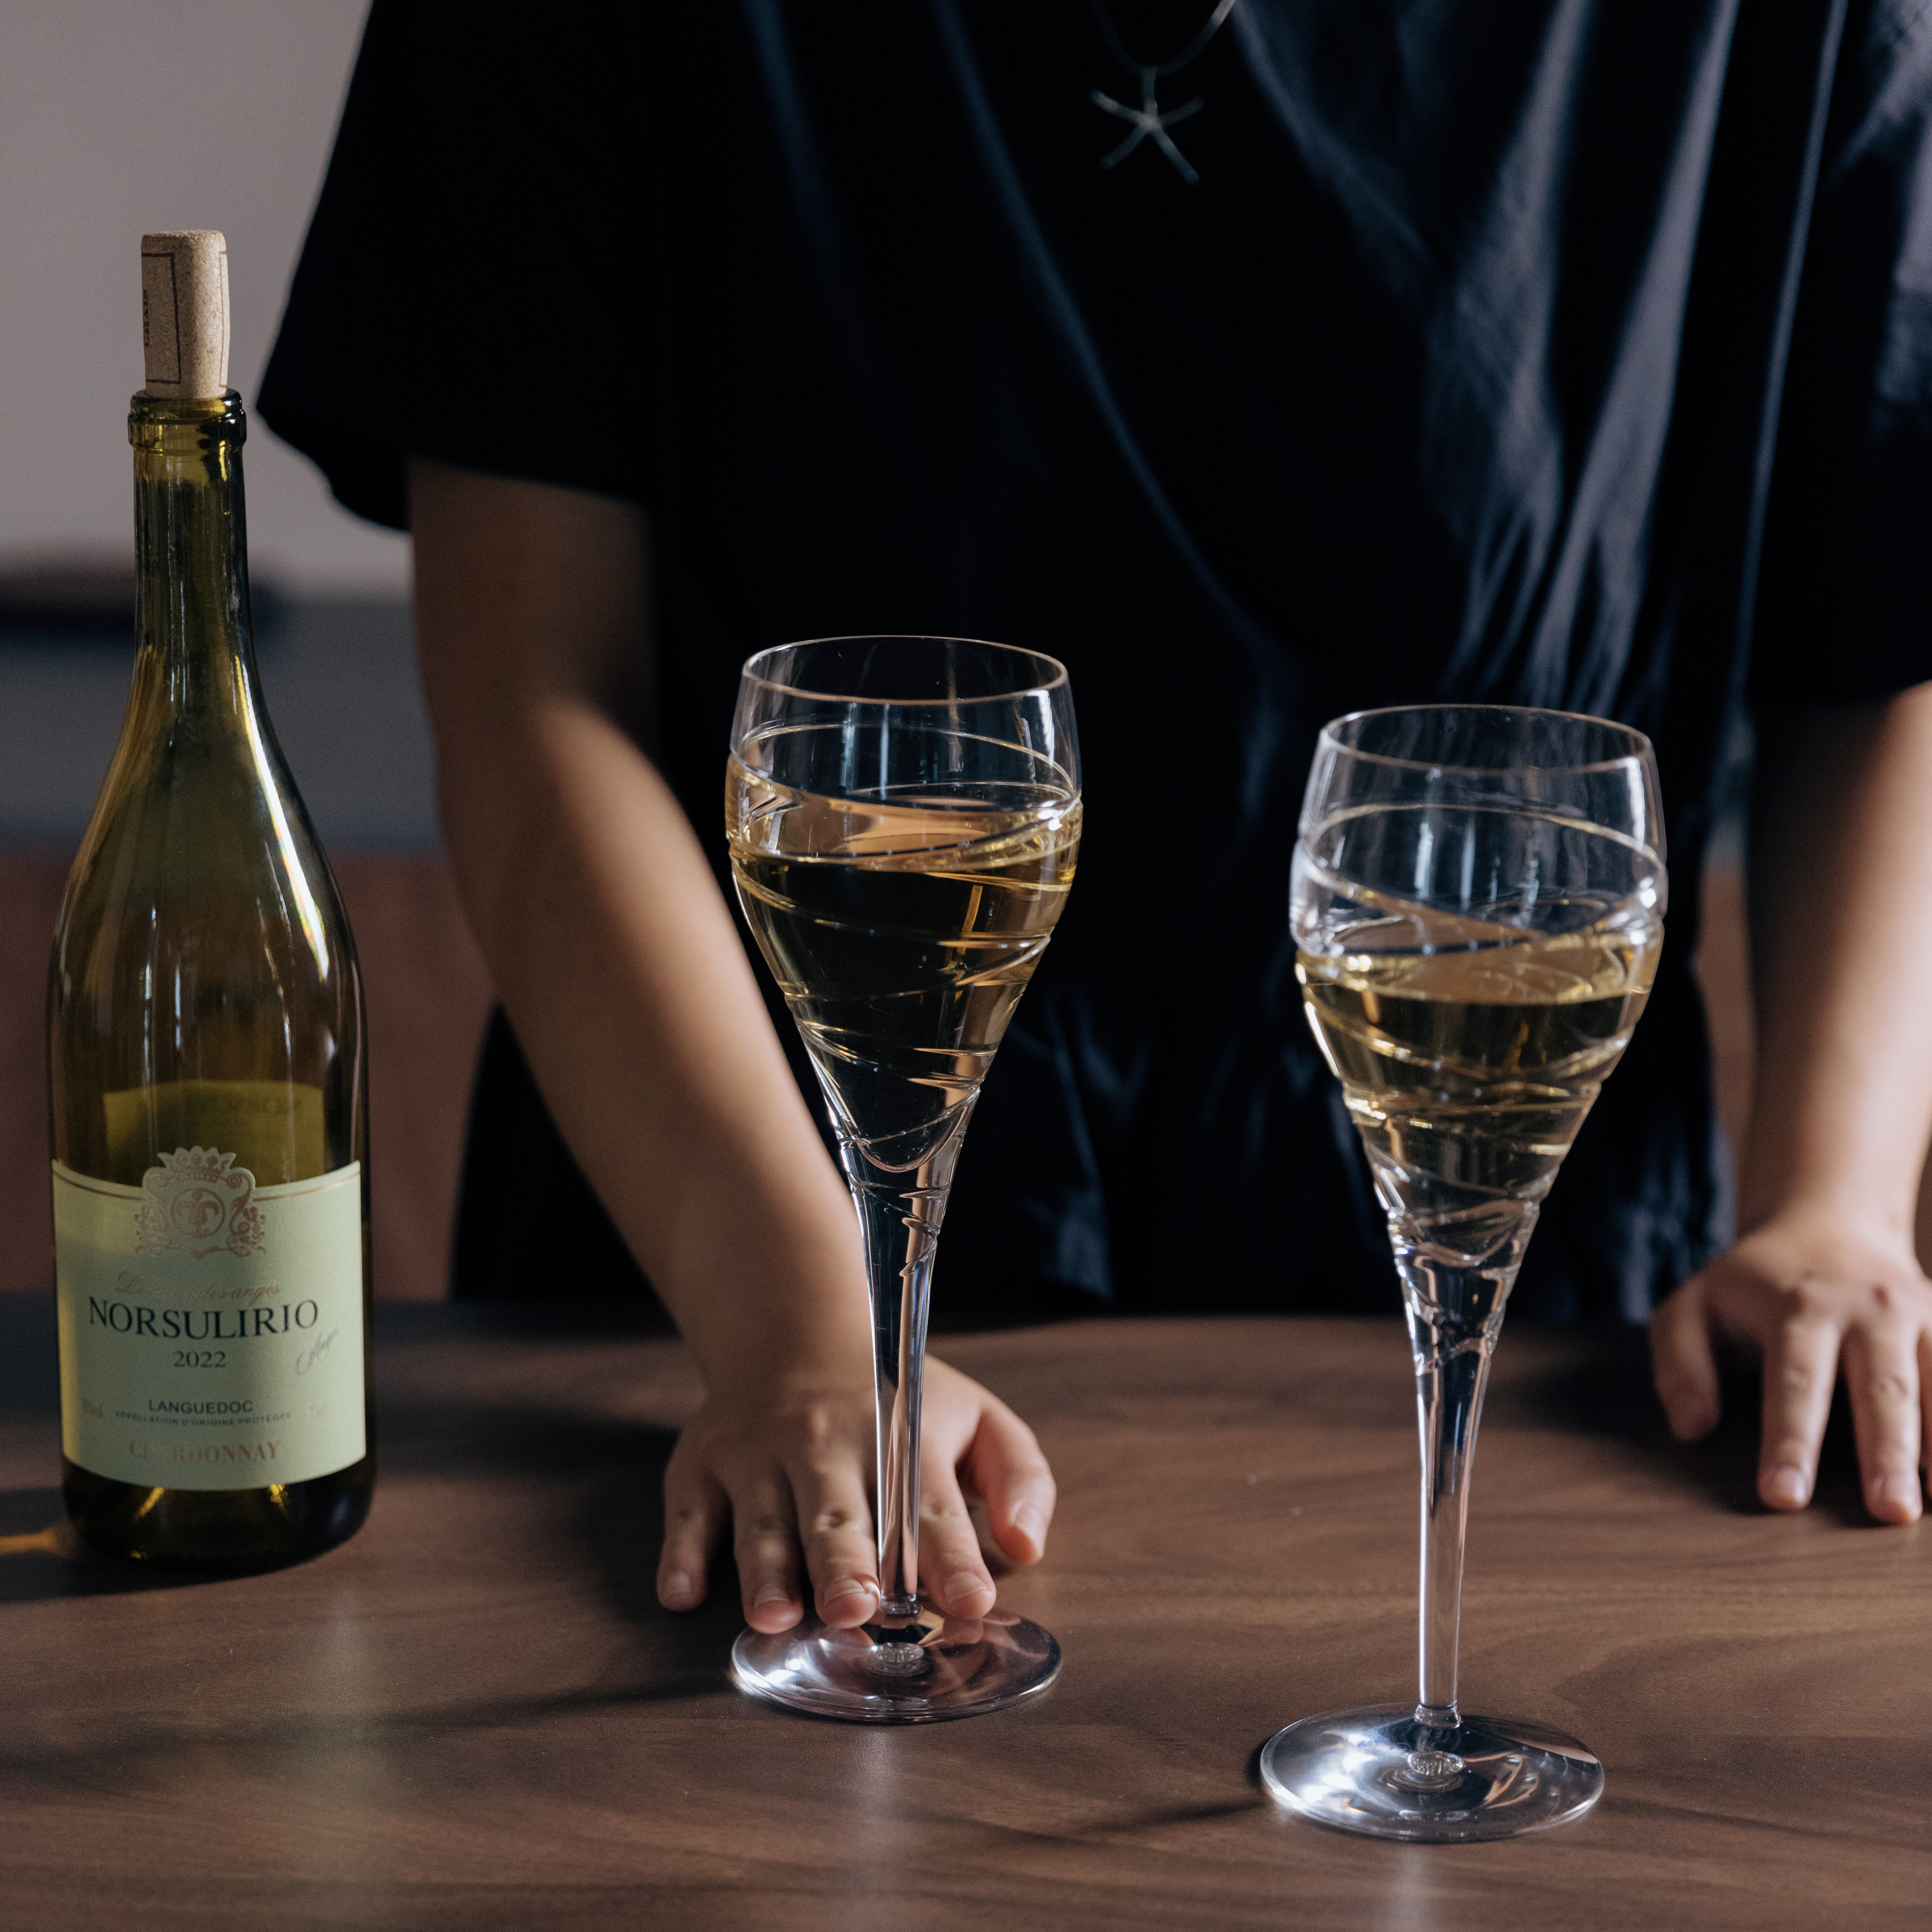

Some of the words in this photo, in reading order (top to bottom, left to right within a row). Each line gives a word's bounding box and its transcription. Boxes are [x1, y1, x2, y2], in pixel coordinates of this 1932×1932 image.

[89, 1296, 319, 1340] NORSULIRIO
[173, 1350, 227, 1368] 2022
[148, 1399, 253, 1414] LANGUEDOC
[129, 1439, 279, 1463] CRDONNAY
